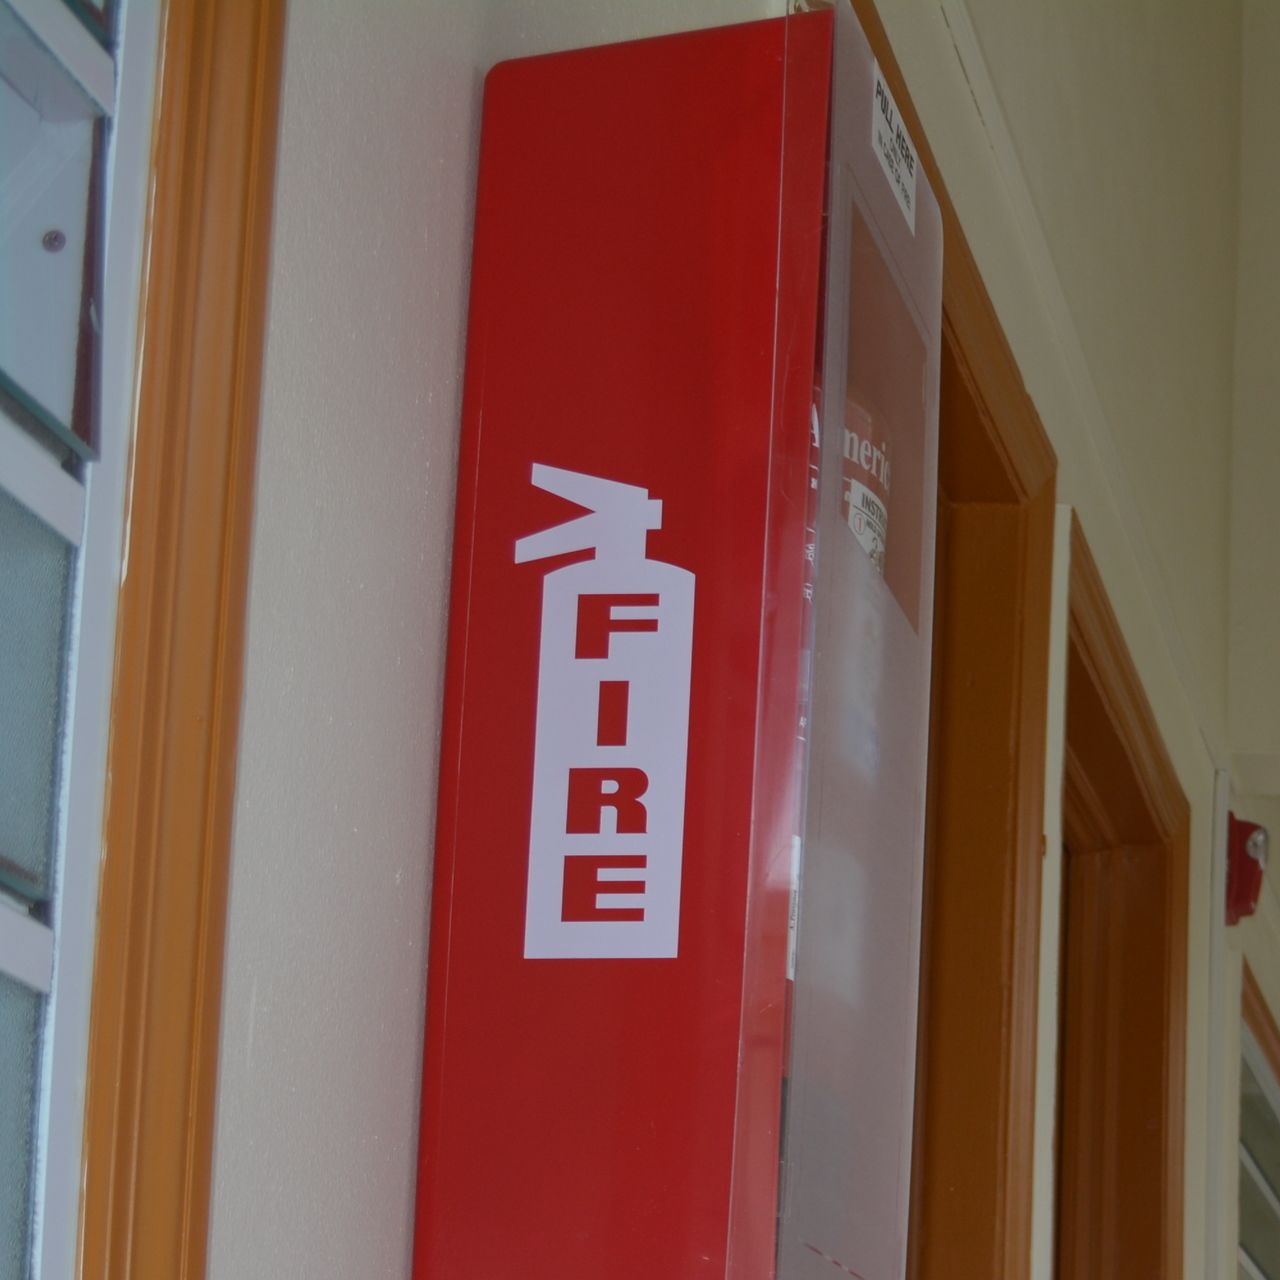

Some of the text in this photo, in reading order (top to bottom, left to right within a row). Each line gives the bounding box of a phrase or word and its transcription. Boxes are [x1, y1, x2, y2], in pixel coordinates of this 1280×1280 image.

[875, 78, 916, 178] PULL HERE
[561, 593, 660, 922] FIRE
